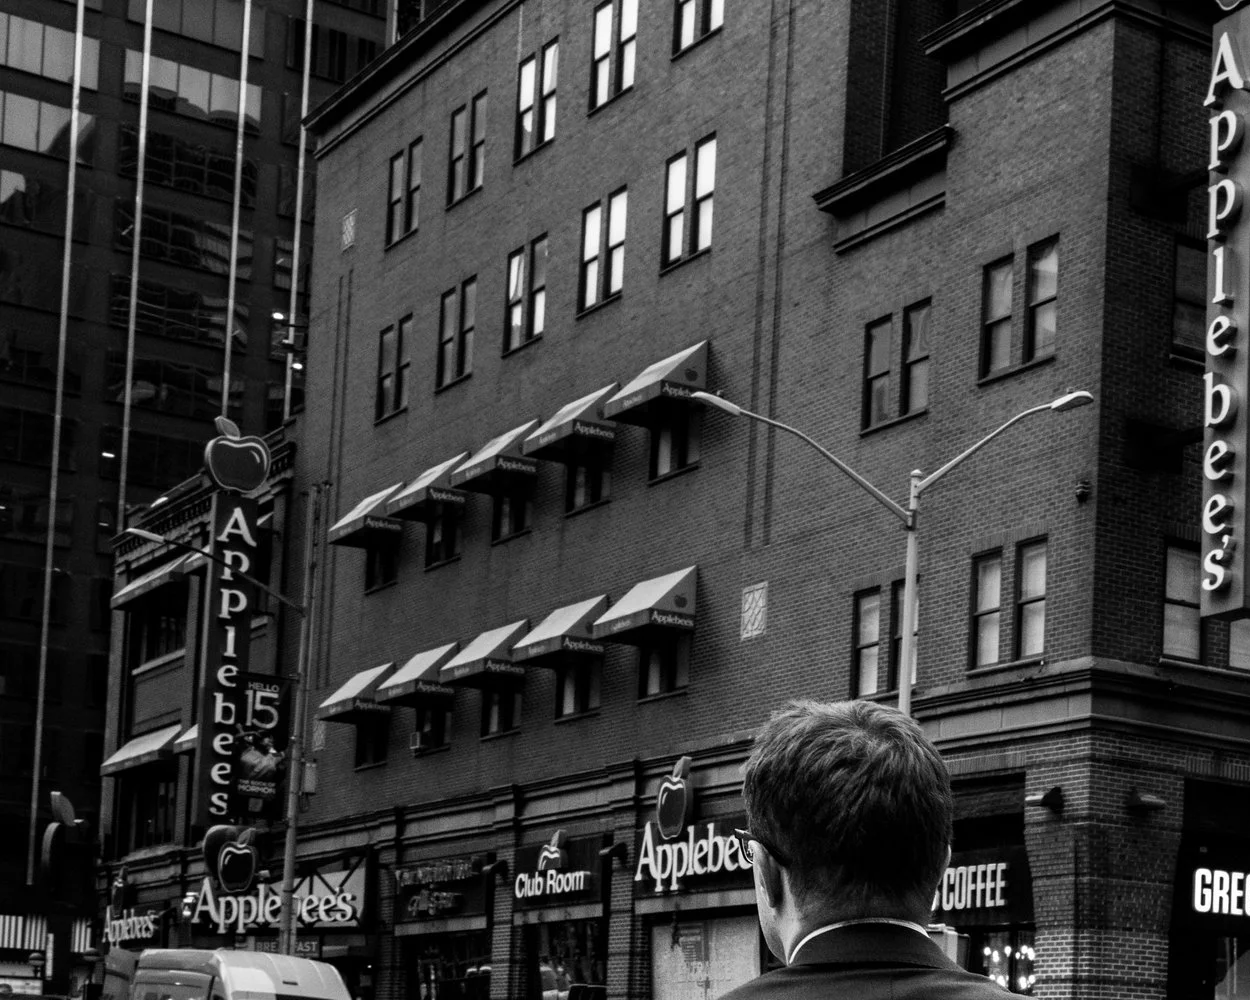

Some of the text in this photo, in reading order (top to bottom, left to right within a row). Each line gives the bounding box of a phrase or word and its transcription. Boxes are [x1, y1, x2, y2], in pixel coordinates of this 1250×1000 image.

[1202, 32, 1244, 591] Applebee's
[248, 682, 280, 692] HELLO
[244, 690, 279, 729] 15
[237, 784, 276, 794] MORMON
[515, 869, 584, 898] Club Room
[942, 863, 1007, 911] COFFEE
[255, 941, 318, 952] BREAST
